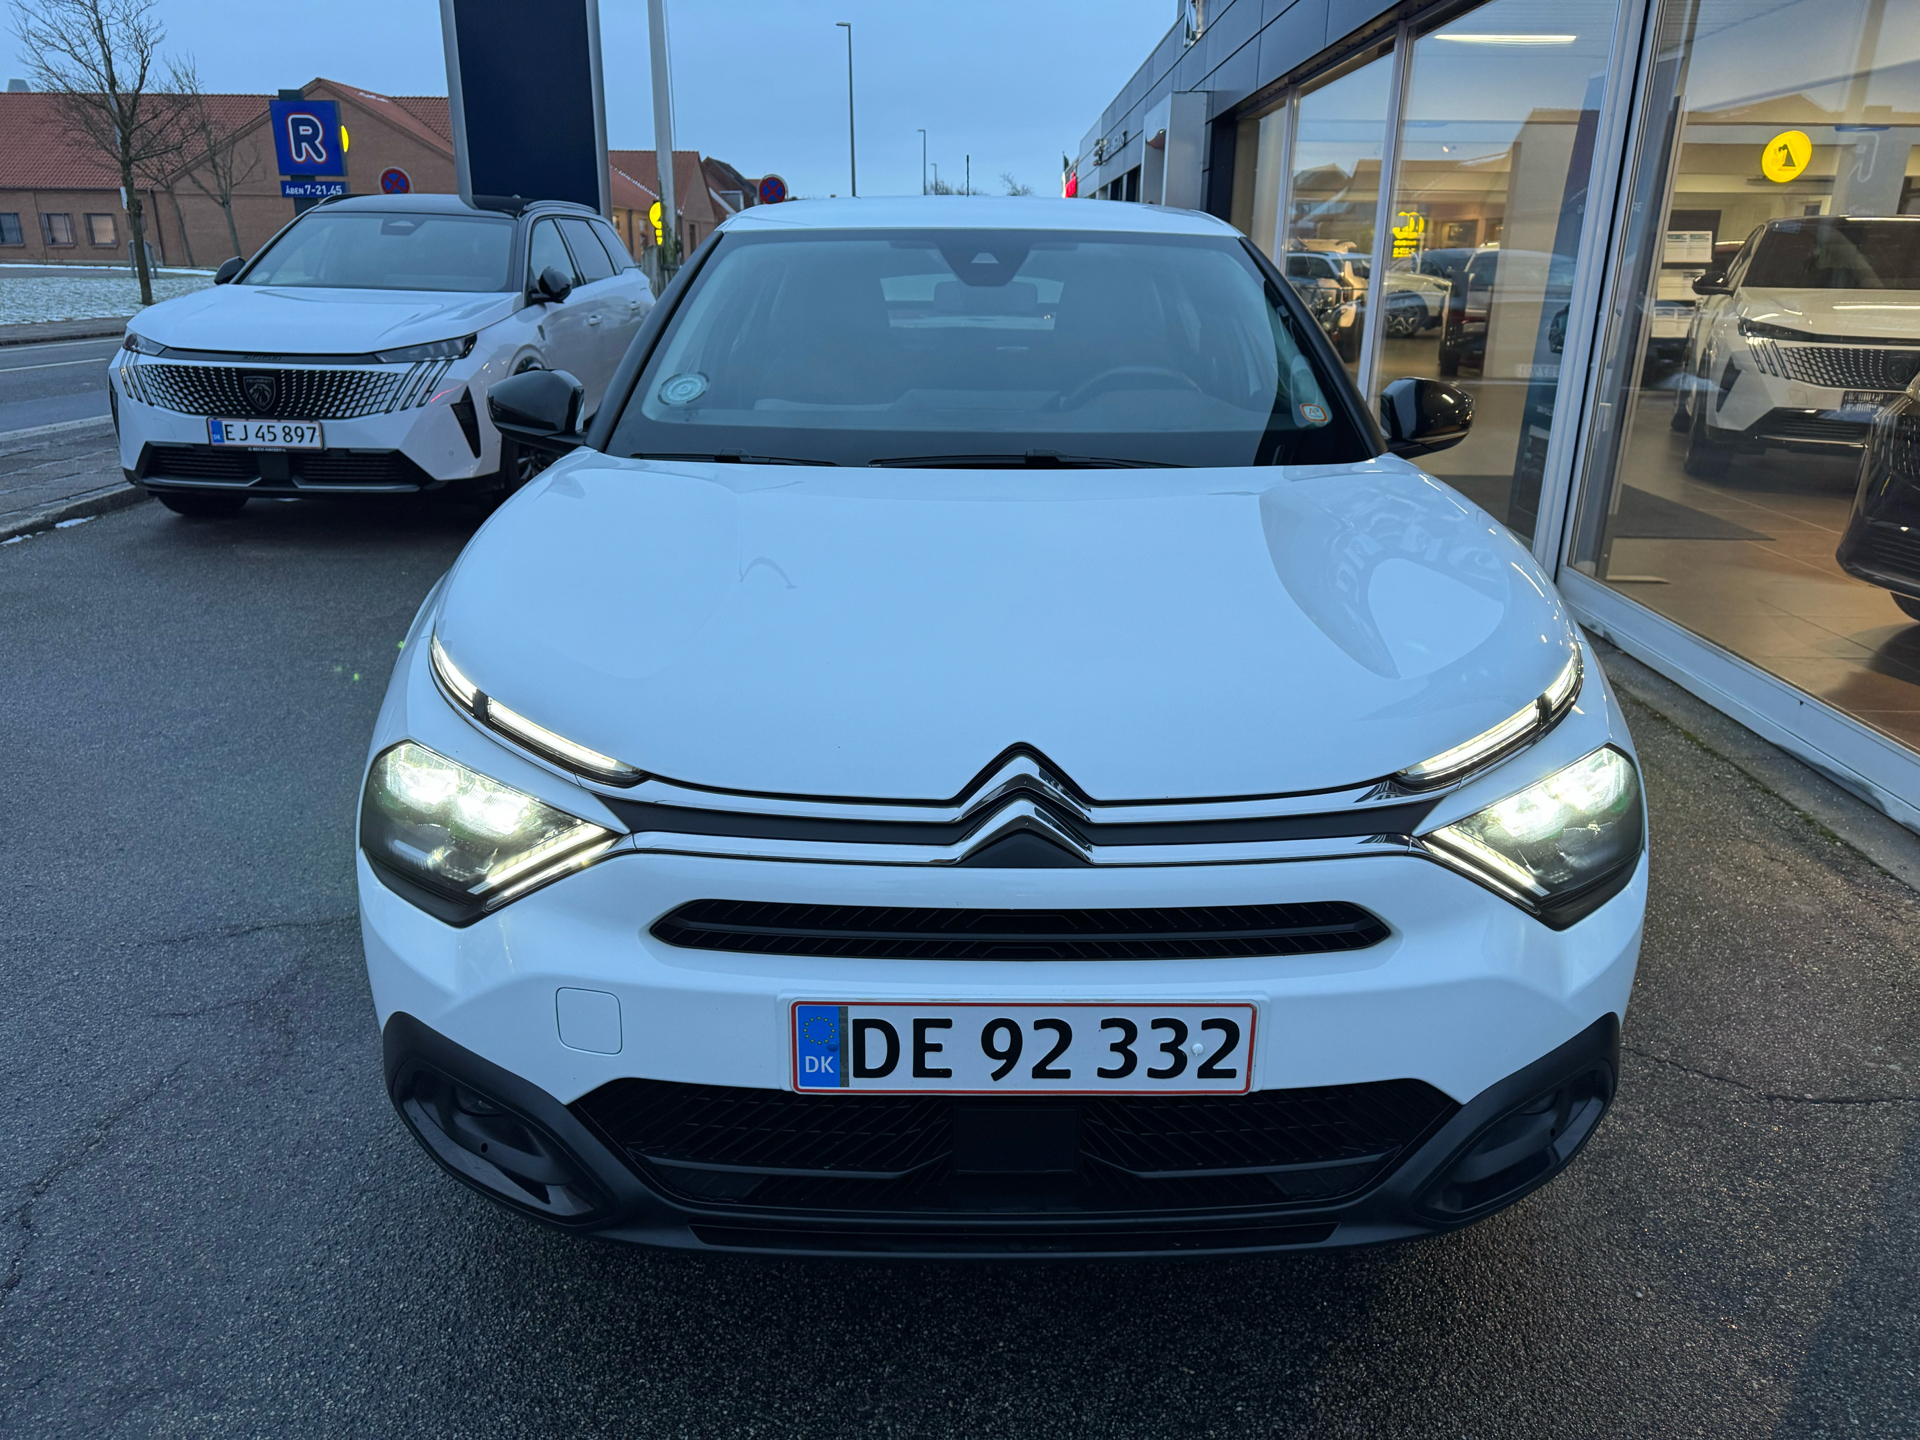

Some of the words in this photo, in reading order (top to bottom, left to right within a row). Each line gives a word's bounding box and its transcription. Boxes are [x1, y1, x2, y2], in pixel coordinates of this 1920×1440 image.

[286, 112, 328, 164] R
[285, 185, 304, 195] ÅBEN
[224, 424, 248, 441] EJ
[255, 425, 277, 442] 45
[282, 425, 316, 443] 897
[852, 1018, 953, 1078] DE
[981, 1017, 1072, 1081] 92
[1097, 1017, 1240, 1079] 332
[805, 1056, 835, 1073] DK
